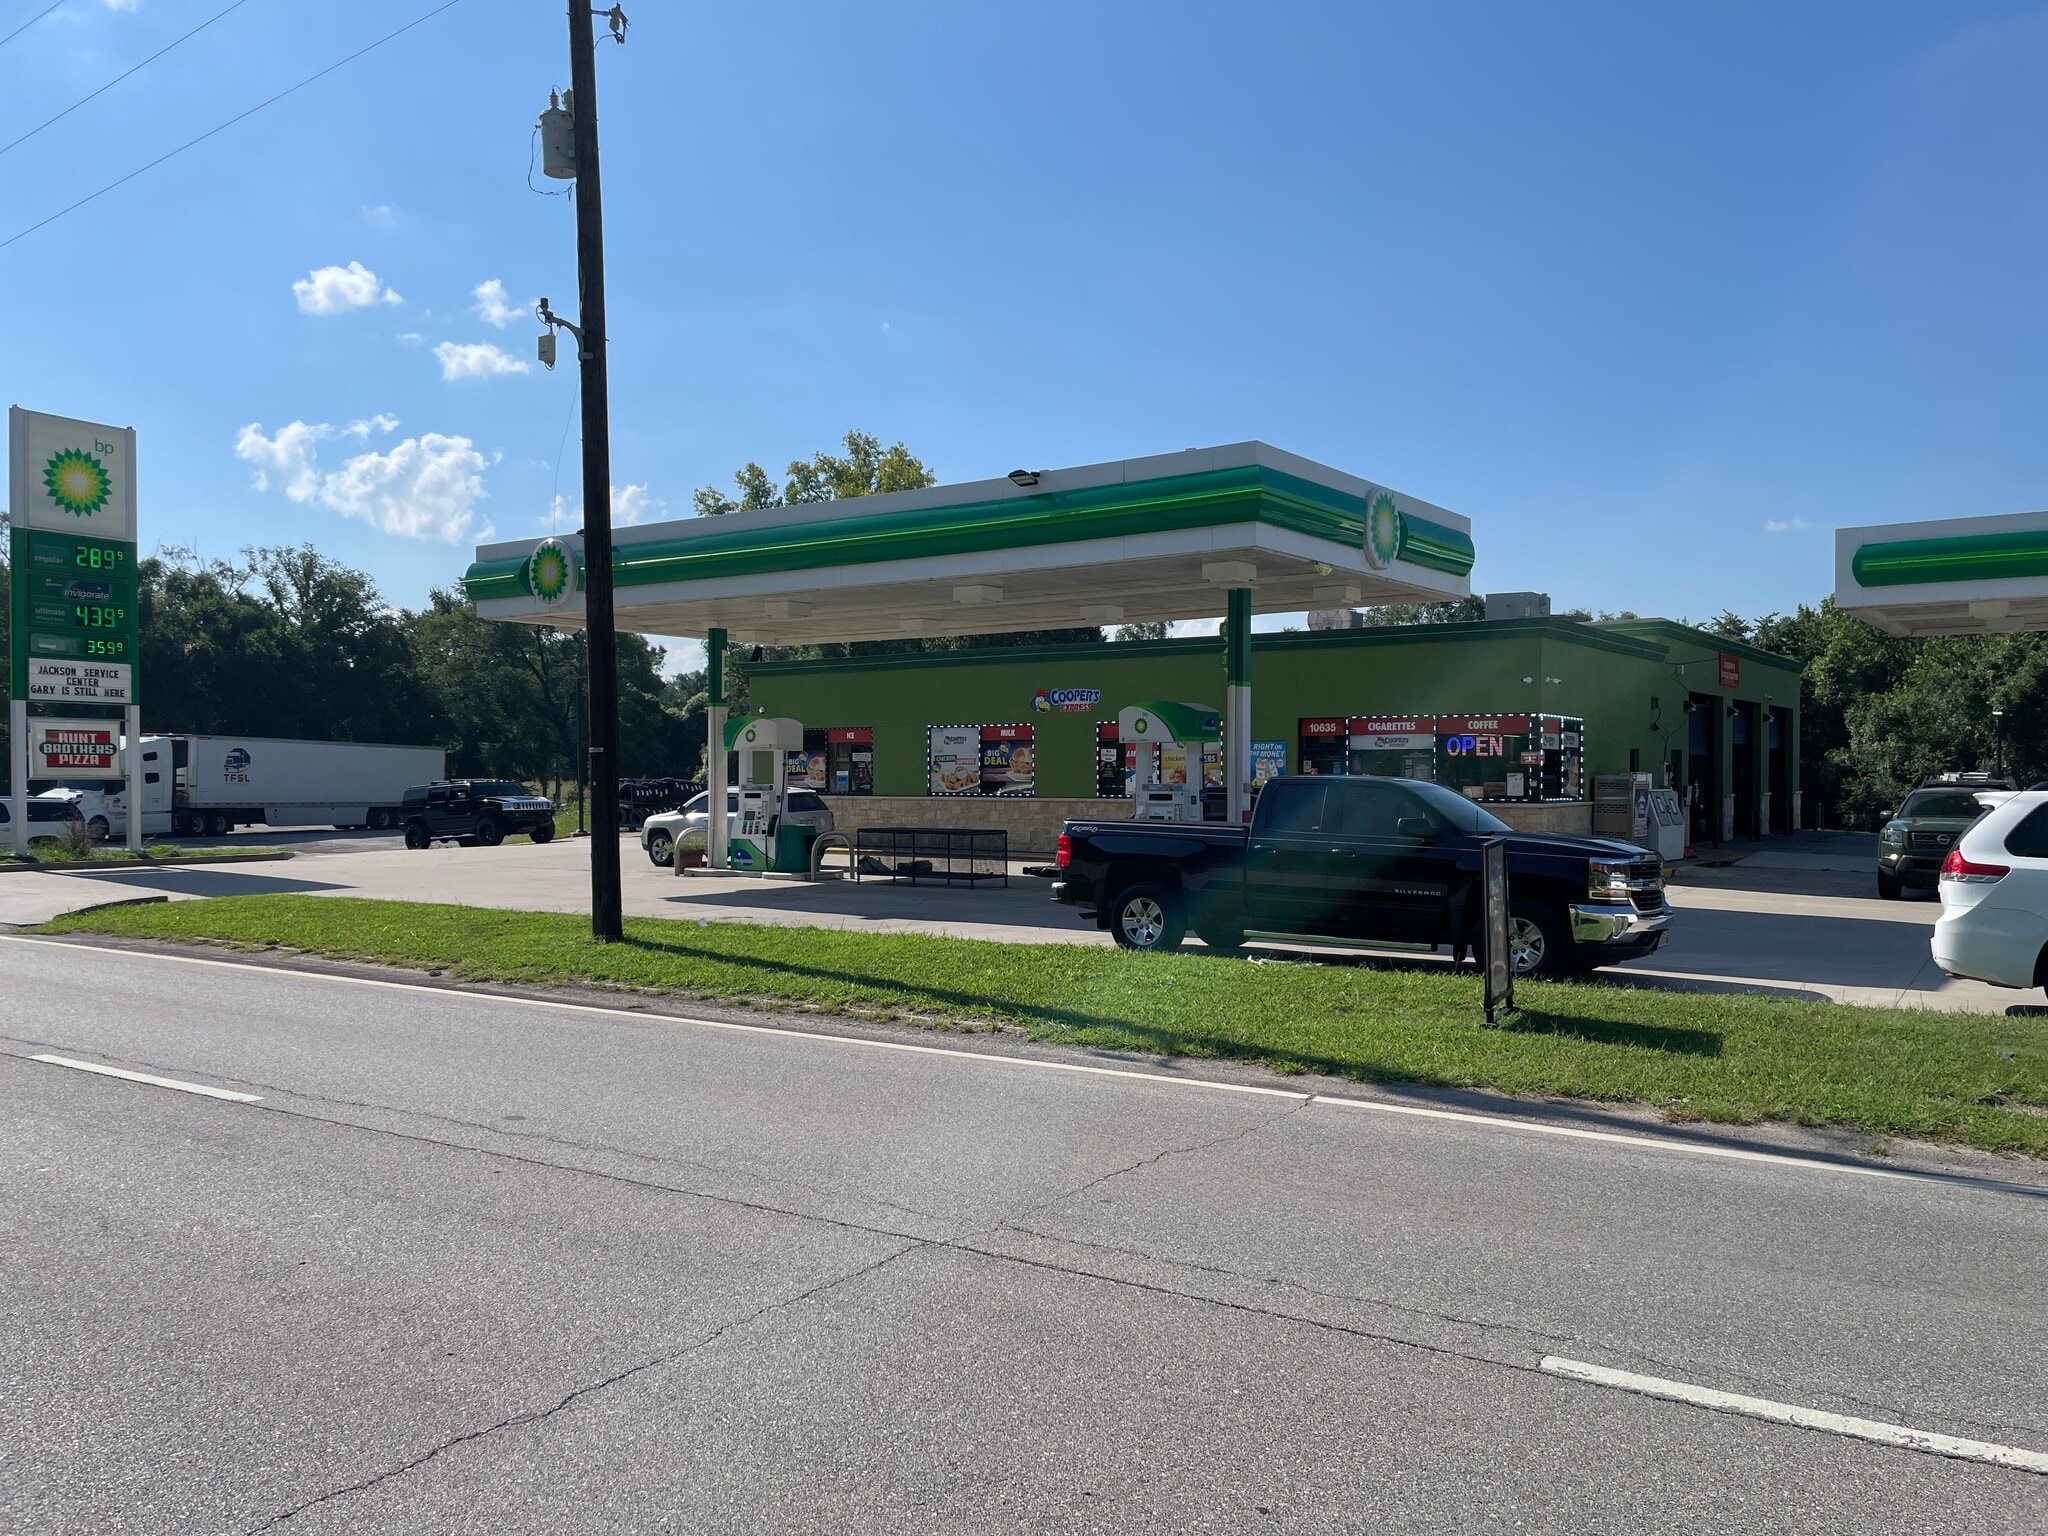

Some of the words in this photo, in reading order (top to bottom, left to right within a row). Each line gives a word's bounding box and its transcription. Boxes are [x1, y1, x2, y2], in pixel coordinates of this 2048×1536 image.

[95, 439, 114, 456] bp
[34, 555, 63, 564] regular
[64, 588, 110, 600] invigorate
[38, 665, 77, 676] JACKSON
[84, 668, 119, 679] SERVICE
[66, 677, 99, 687] CENTER
[30, 684, 55, 695] GARY
[61, 686, 70, 696] IS
[74, 686, 98, 697] STILL
[104, 688, 125, 698] HERE
[1050, 689, 1100, 705] COOPER'S
[1060, 703, 1092, 712] EXPRESS
[1309, 723, 1337, 733] 10635
[1367, 721, 1417, 731] CIGARETTES
[1467, 720, 1499, 730] COFFEE
[58, 732, 98, 744] HUNT
[846, 732, 855, 740] ICE
[1000, 729, 1016, 737] MILK
[43, 743, 114, 755] BROTHERS
[1253, 743, 1275, 751] RIGHT
[1446, 735, 1503, 757] OPEN
[987, 749, 1000, 757] BIG
[1260, 750, 1286, 758] MONEY
[58, 754, 100, 765] PIZZA
[984, 756, 1008, 765] DEAL
[223, 773, 250, 783] TFSL
[1394, 888, 1442, 896] SILVERADO
